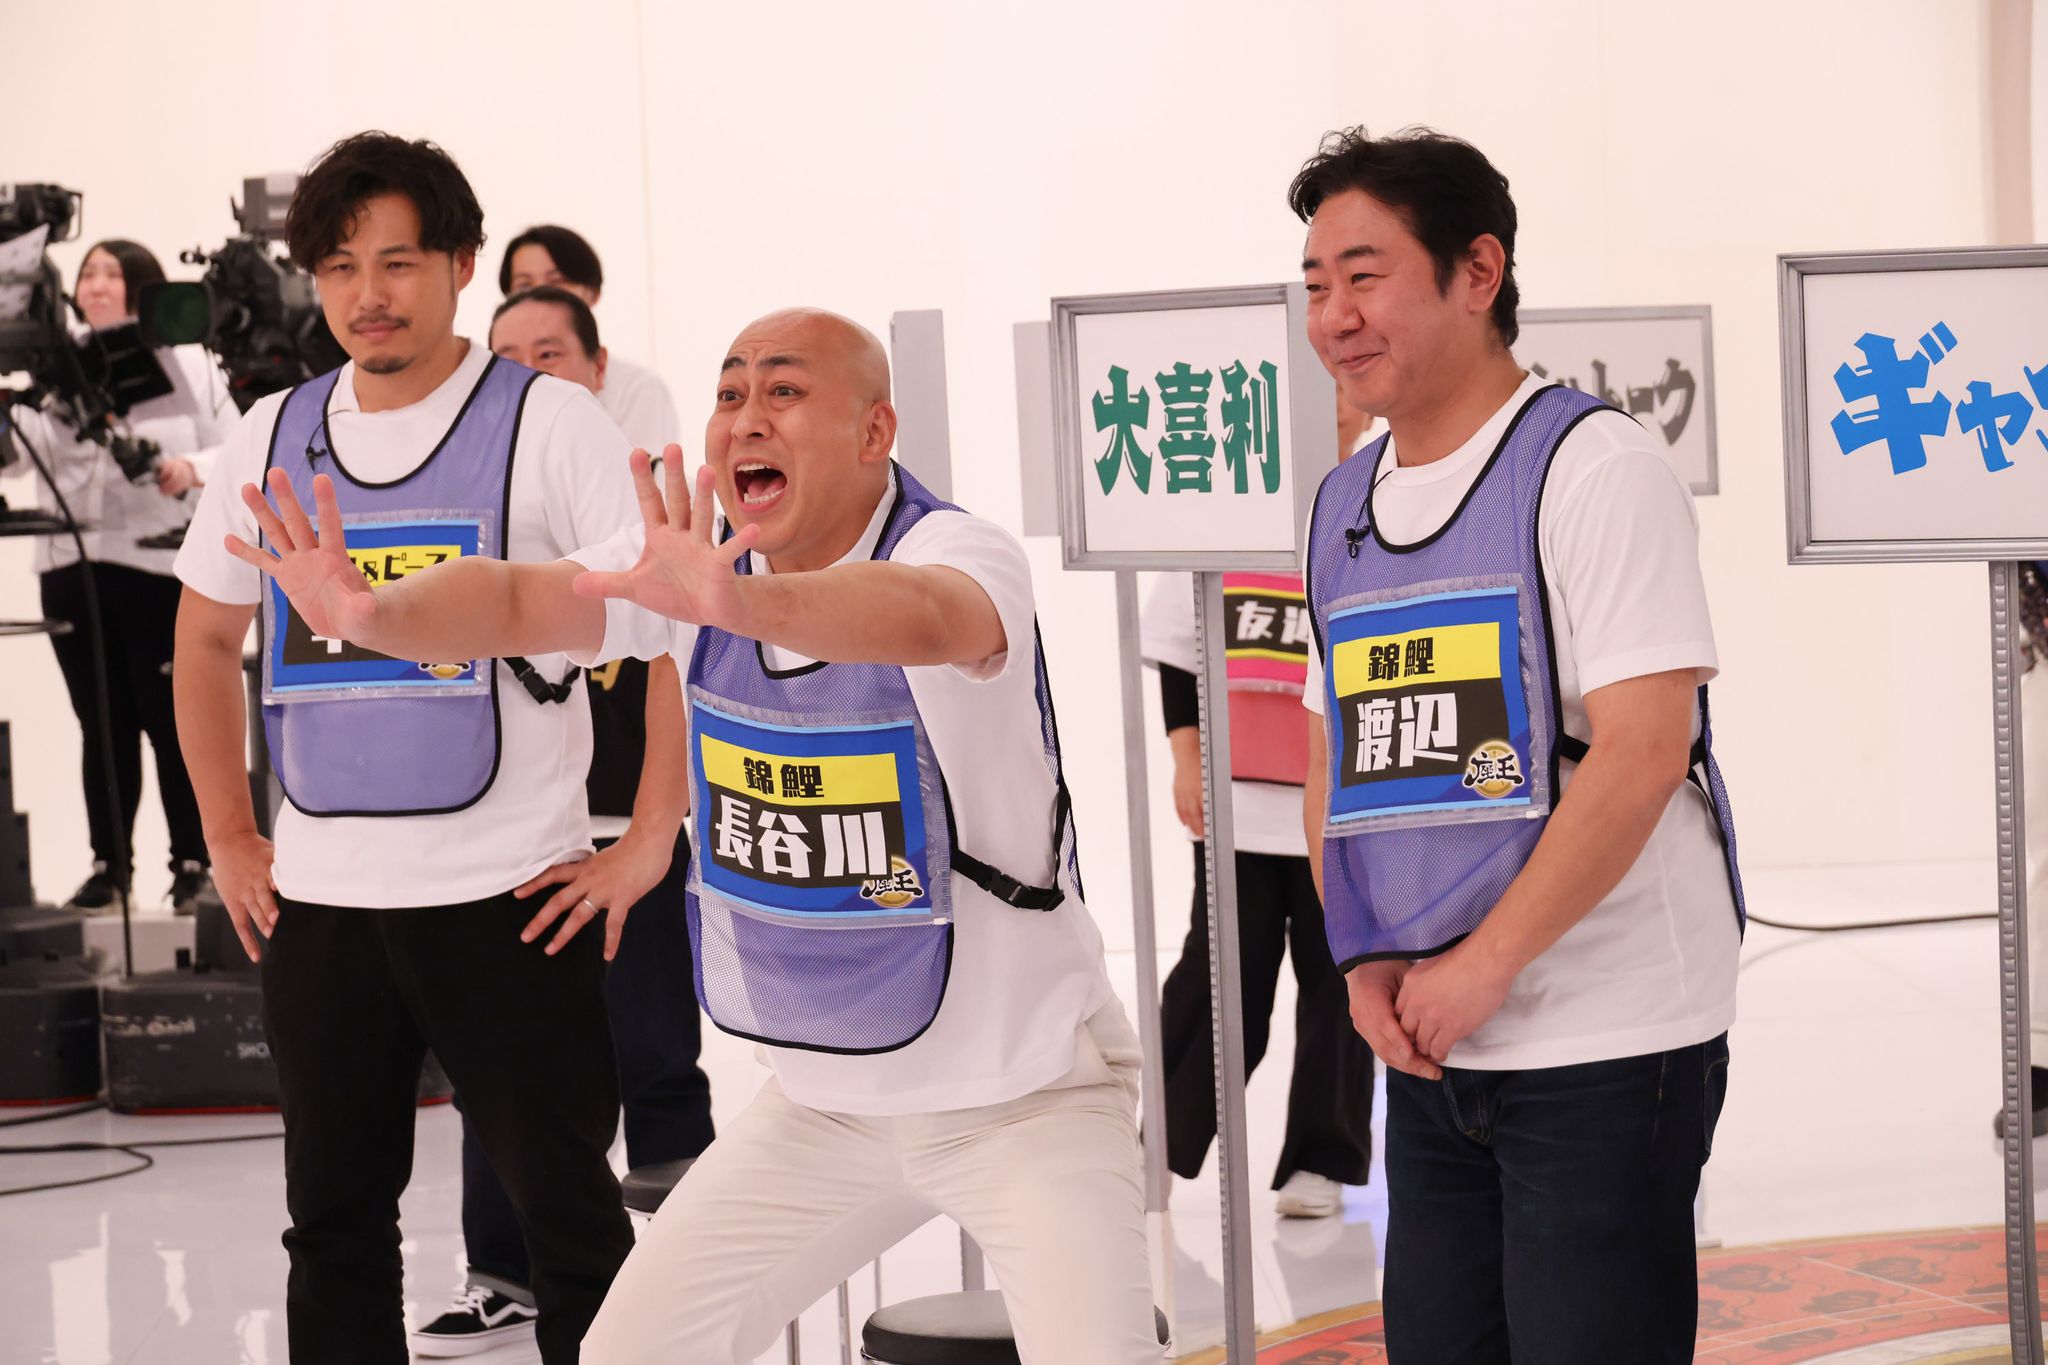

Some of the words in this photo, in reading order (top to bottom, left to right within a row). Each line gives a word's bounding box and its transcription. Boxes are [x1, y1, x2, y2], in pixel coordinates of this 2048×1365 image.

[1092, 359, 1281, 496] 大喜利
[1368, 637, 1435, 682] 錦鯉
[1355, 692, 1459, 773] 渡辺
[743, 756, 825, 798] 錦鯉
[715, 794, 888, 878] 長谷川
